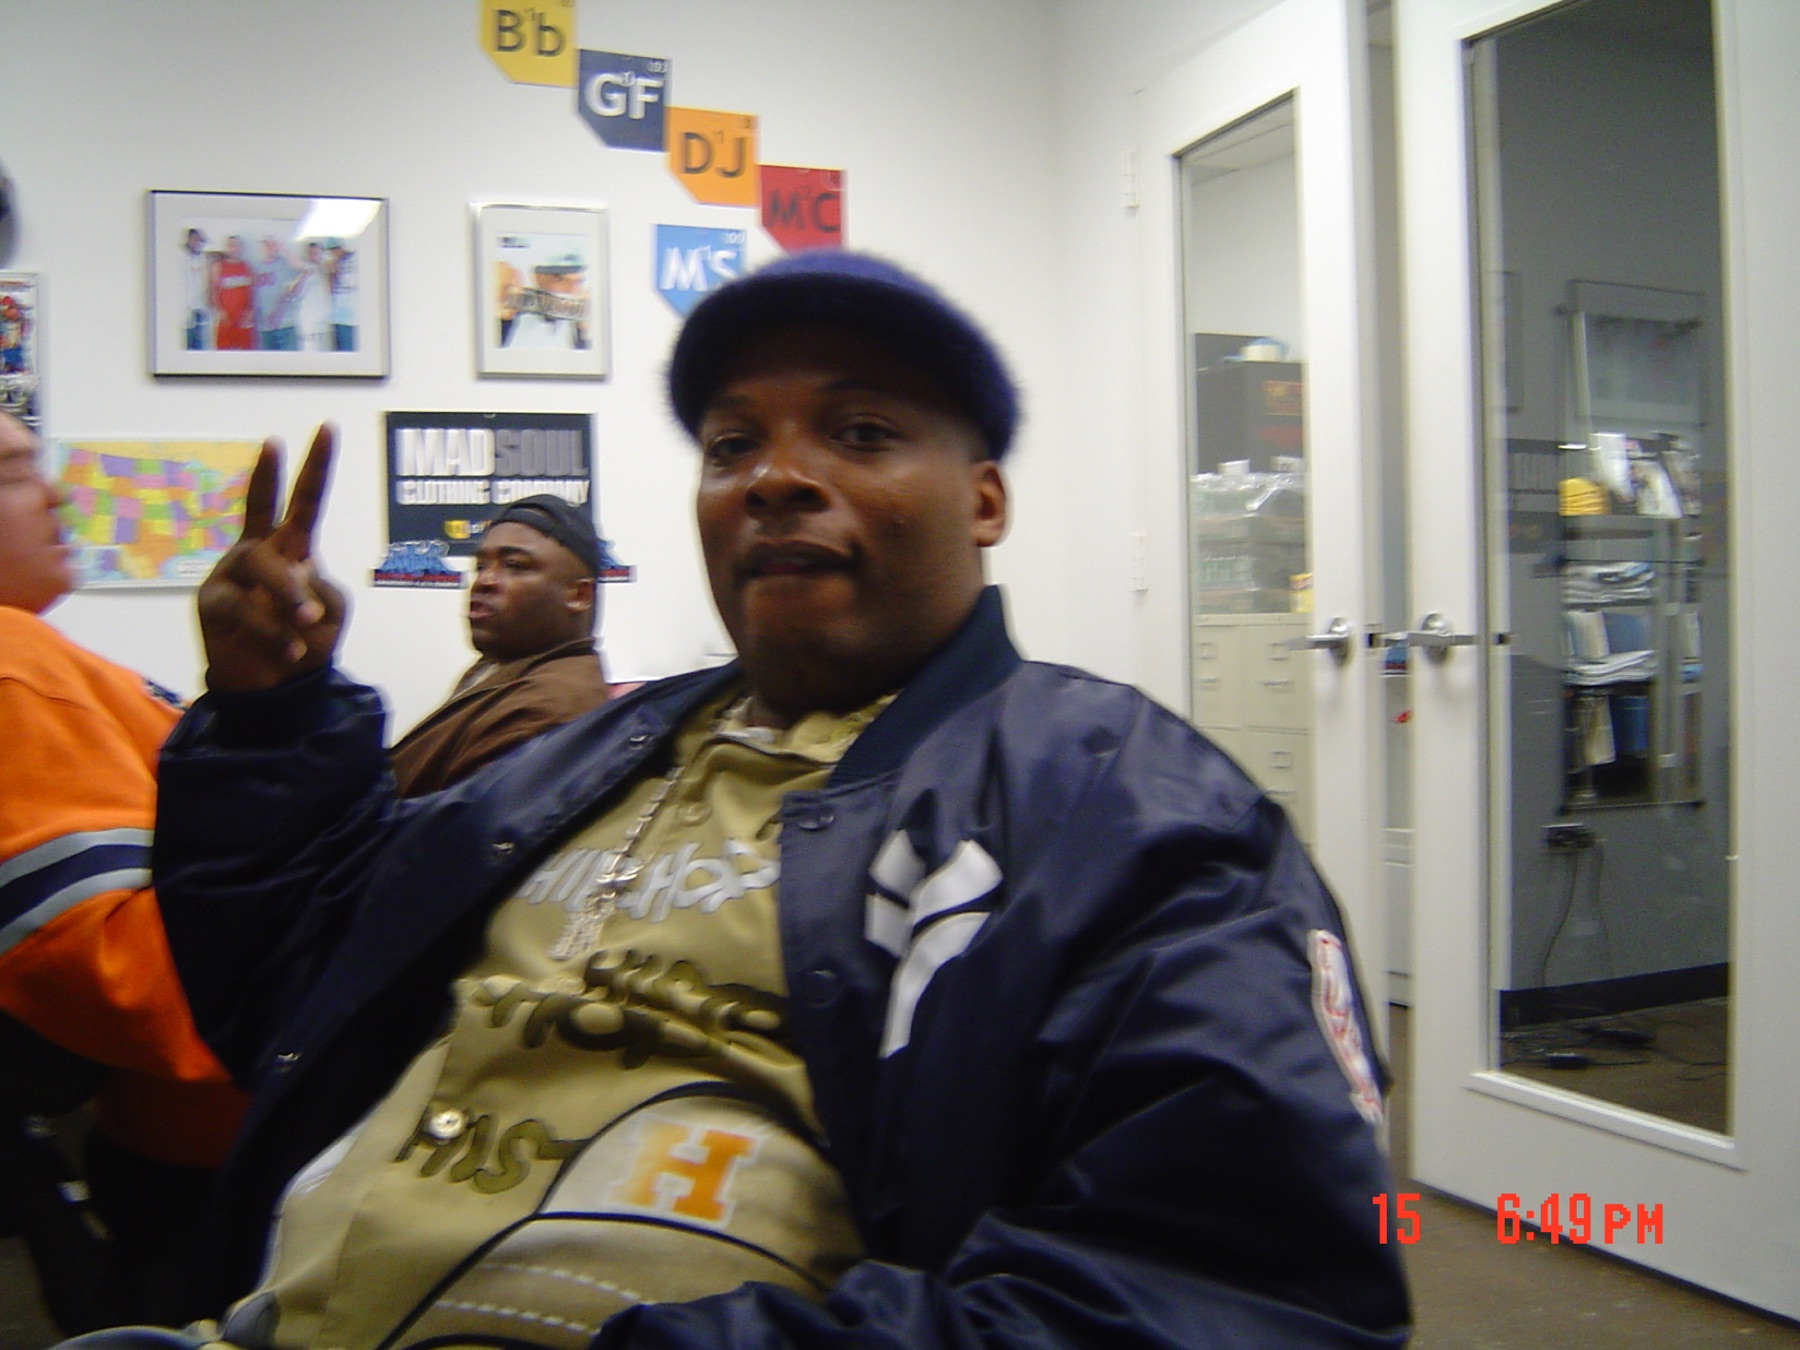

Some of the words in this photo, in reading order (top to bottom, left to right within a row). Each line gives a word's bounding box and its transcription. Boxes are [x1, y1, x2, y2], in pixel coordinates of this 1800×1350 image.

[493, 9, 566, 57] Bb
[584, 73, 664, 119] GF
[682, 132, 746, 178] DJ
[768, 190, 841, 233] MC
[606, 1116, 764, 1229] H
